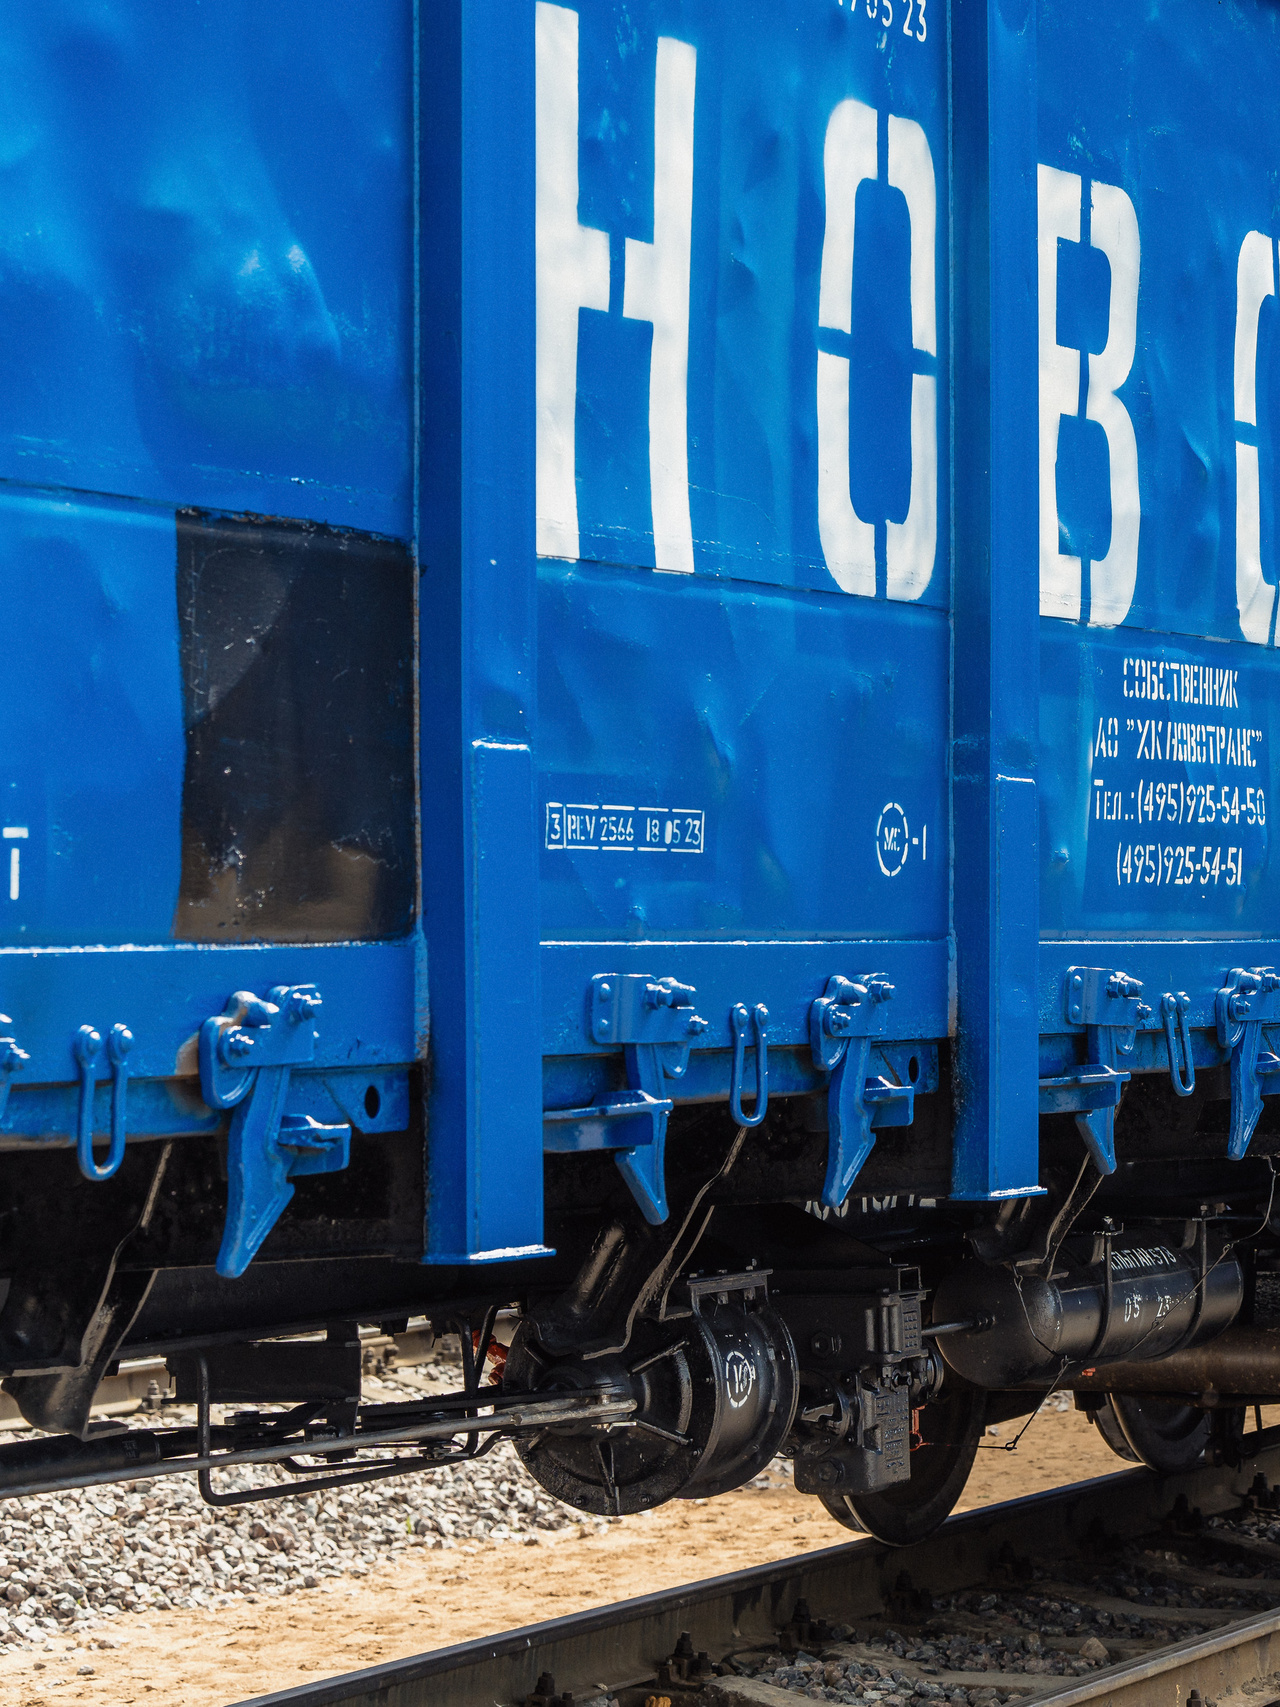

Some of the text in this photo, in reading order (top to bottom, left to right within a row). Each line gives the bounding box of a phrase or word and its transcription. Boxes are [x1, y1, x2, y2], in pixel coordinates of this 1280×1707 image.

[1123, 658, 1239, 708] СОБСТВЕННИК
[1095, 717, 1119, 758] АО
[551, 814, 561, 840] 3
[600, 816, 635, 842] 2566
[1116, 842, 1243, 886] (495)925-54-51
